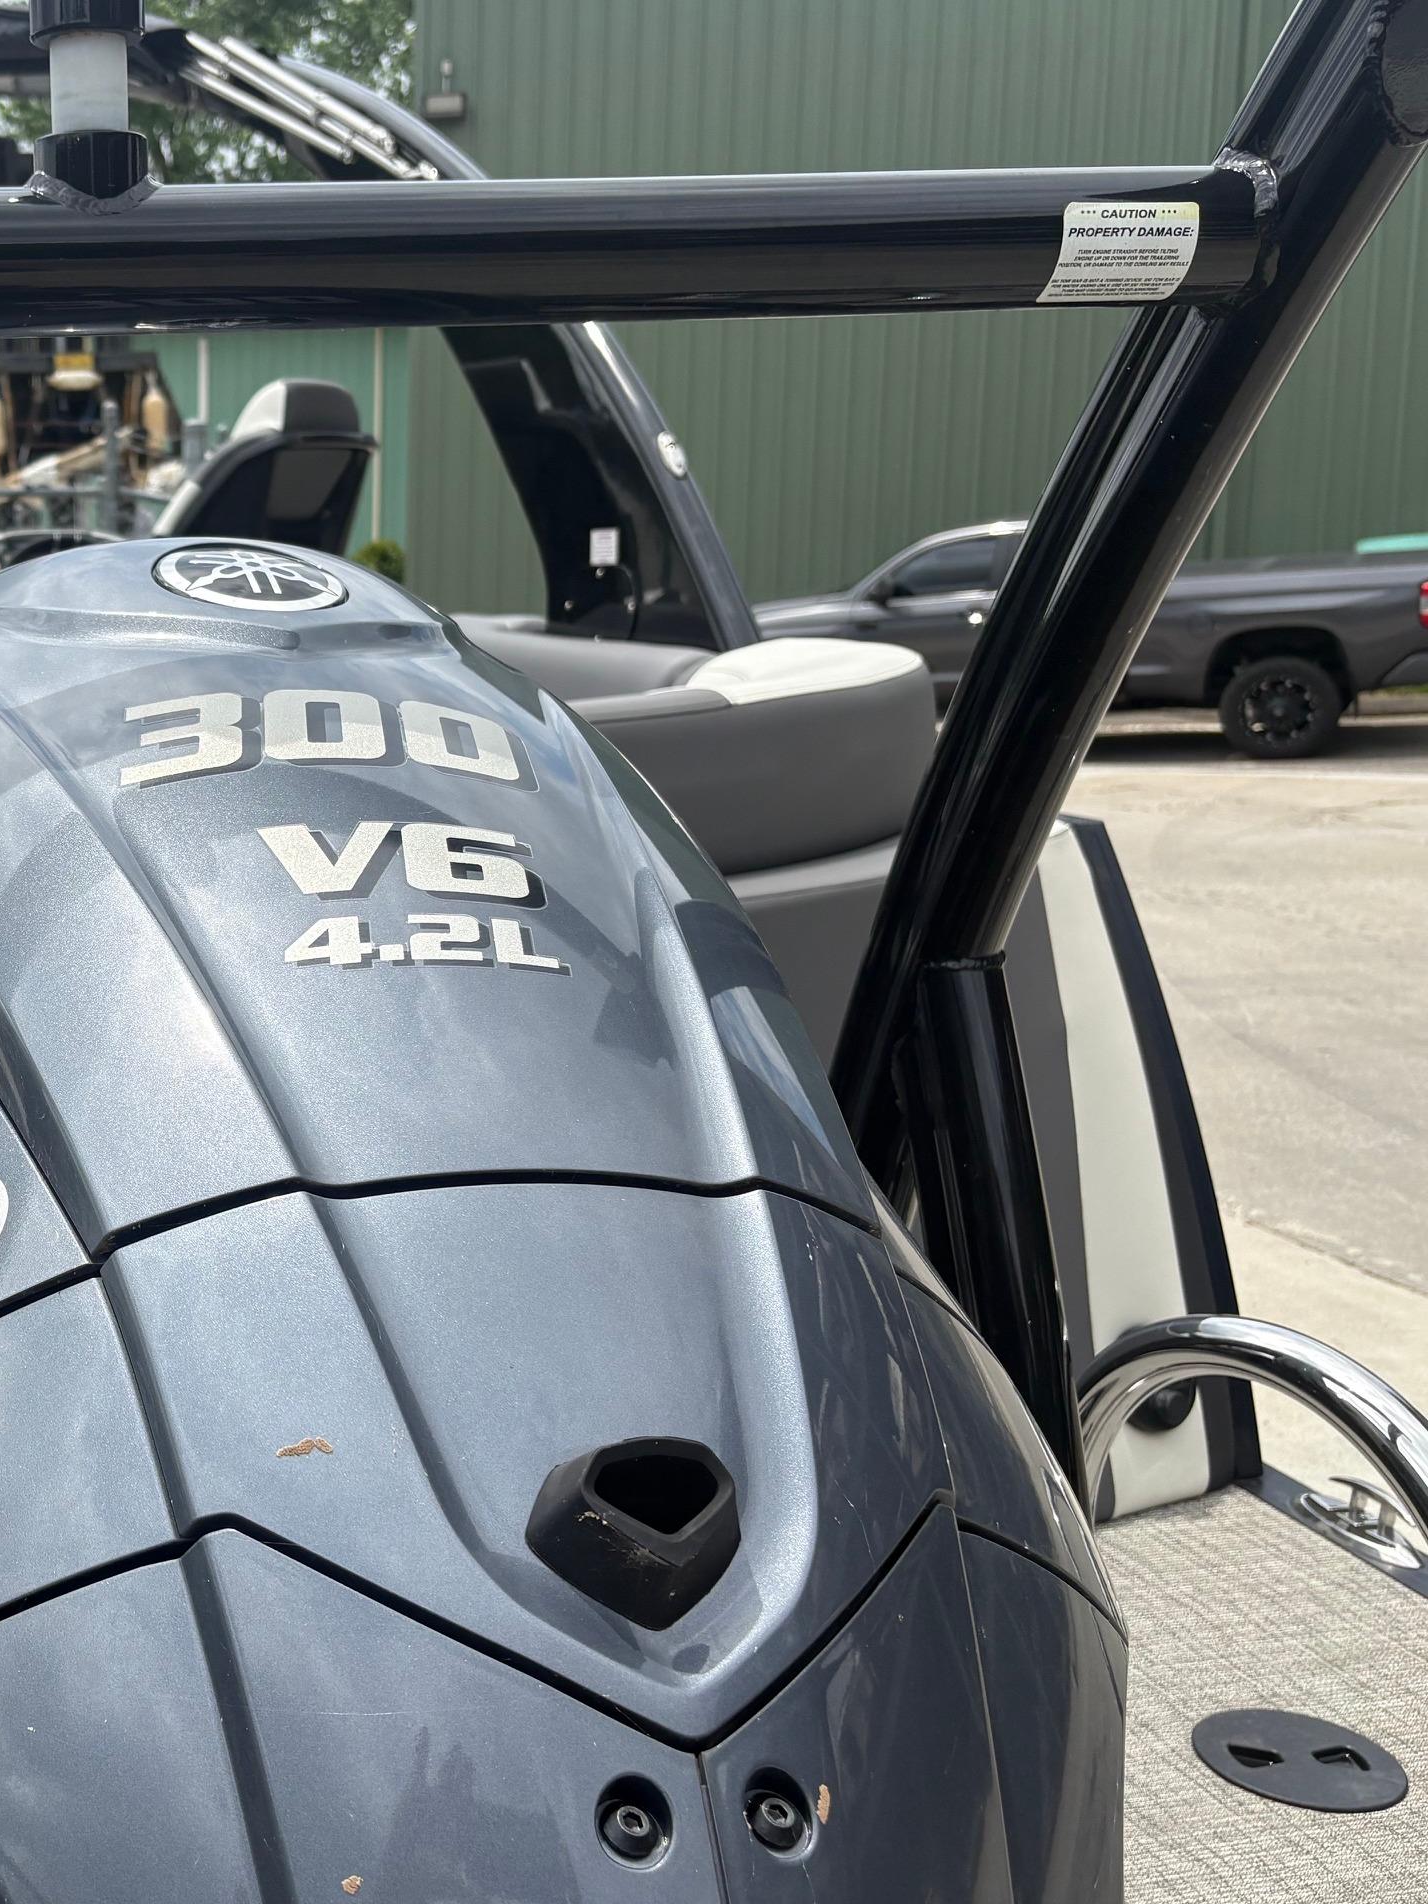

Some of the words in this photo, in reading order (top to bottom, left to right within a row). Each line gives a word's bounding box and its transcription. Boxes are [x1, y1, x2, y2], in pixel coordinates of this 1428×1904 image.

[1068, 227, 1136, 238] PROPERTY
[1137, 226, 1195, 237] DAMAGE:
[1101, 209, 1157, 219] CAUTION
[120, 690, 534, 792] 300
[256, 821, 546, 910] V6
[284, 914, 572, 976] 4.2L
